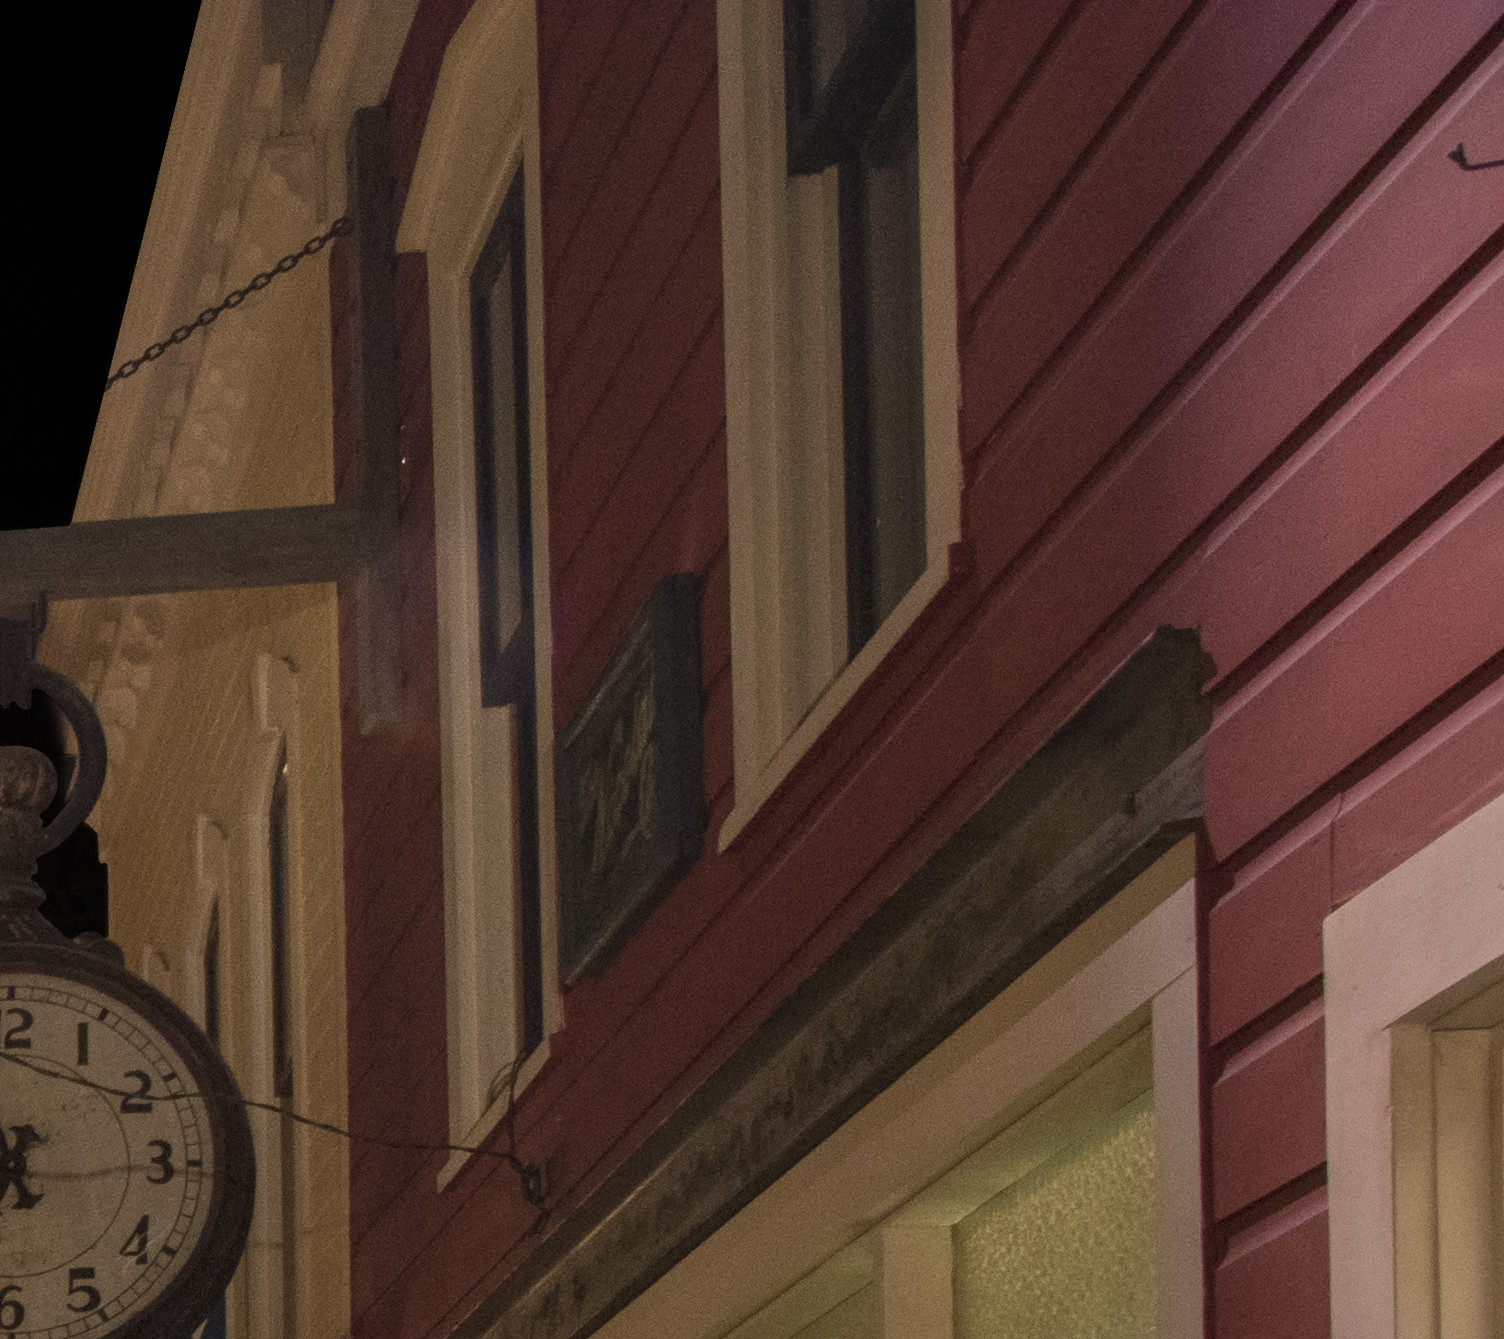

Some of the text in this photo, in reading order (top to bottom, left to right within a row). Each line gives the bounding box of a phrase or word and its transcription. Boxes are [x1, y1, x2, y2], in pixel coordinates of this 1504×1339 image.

[77, 1023, 89, 1065] 1
[120, 1071, 154, 1114] 2
[146, 1140, 174, 1184] 3
[119, 1215, 150, 1265] 4
[67, 1268, 101, 1313] 5
